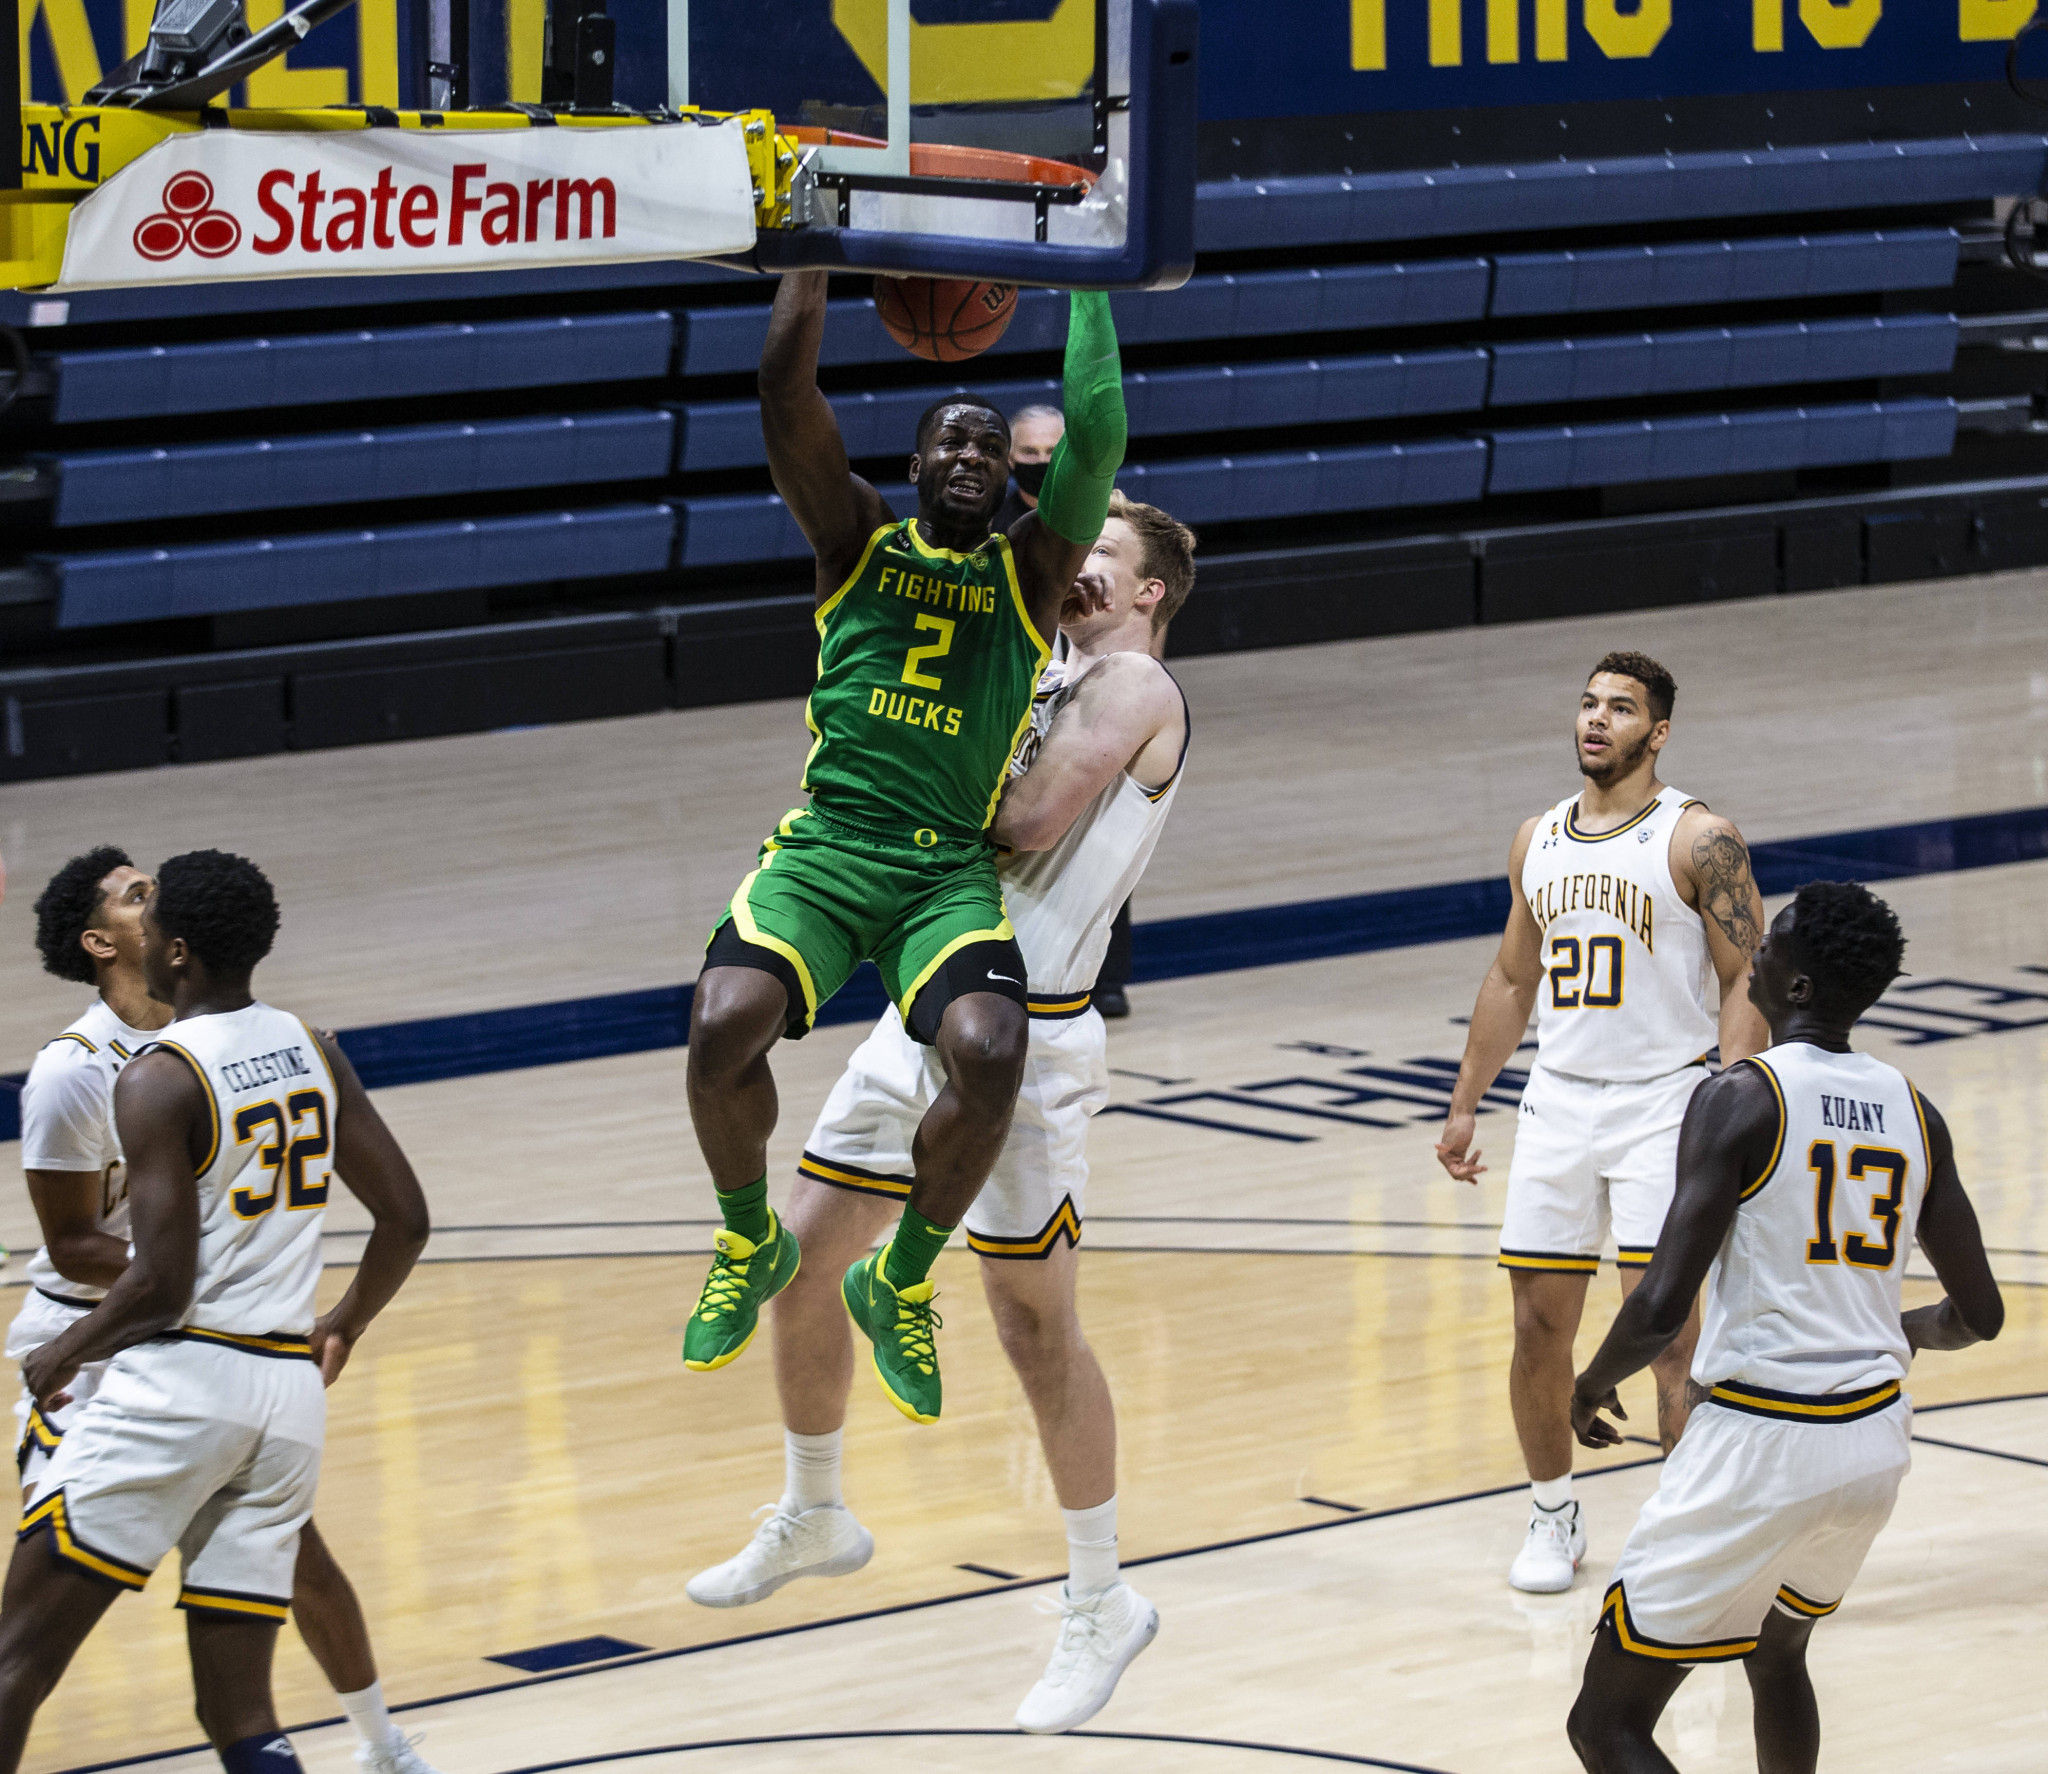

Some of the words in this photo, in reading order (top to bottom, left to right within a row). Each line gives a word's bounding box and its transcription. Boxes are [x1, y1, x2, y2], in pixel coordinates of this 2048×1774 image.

[878, 567, 995, 614] FIGHTING
[901, 612, 956, 691] 2
[868, 687, 963, 736] DUCKS
[1531, 873, 1653, 956] ALIFORNIA
[1549, 933, 1625, 1010] 20
[221, 1046, 311, 1094] CELESTINE
[1820, 1094, 1886, 1134] KUANY
[229, 1086, 331, 1221] 32
[1805, 1138, 1910, 1271] 13
